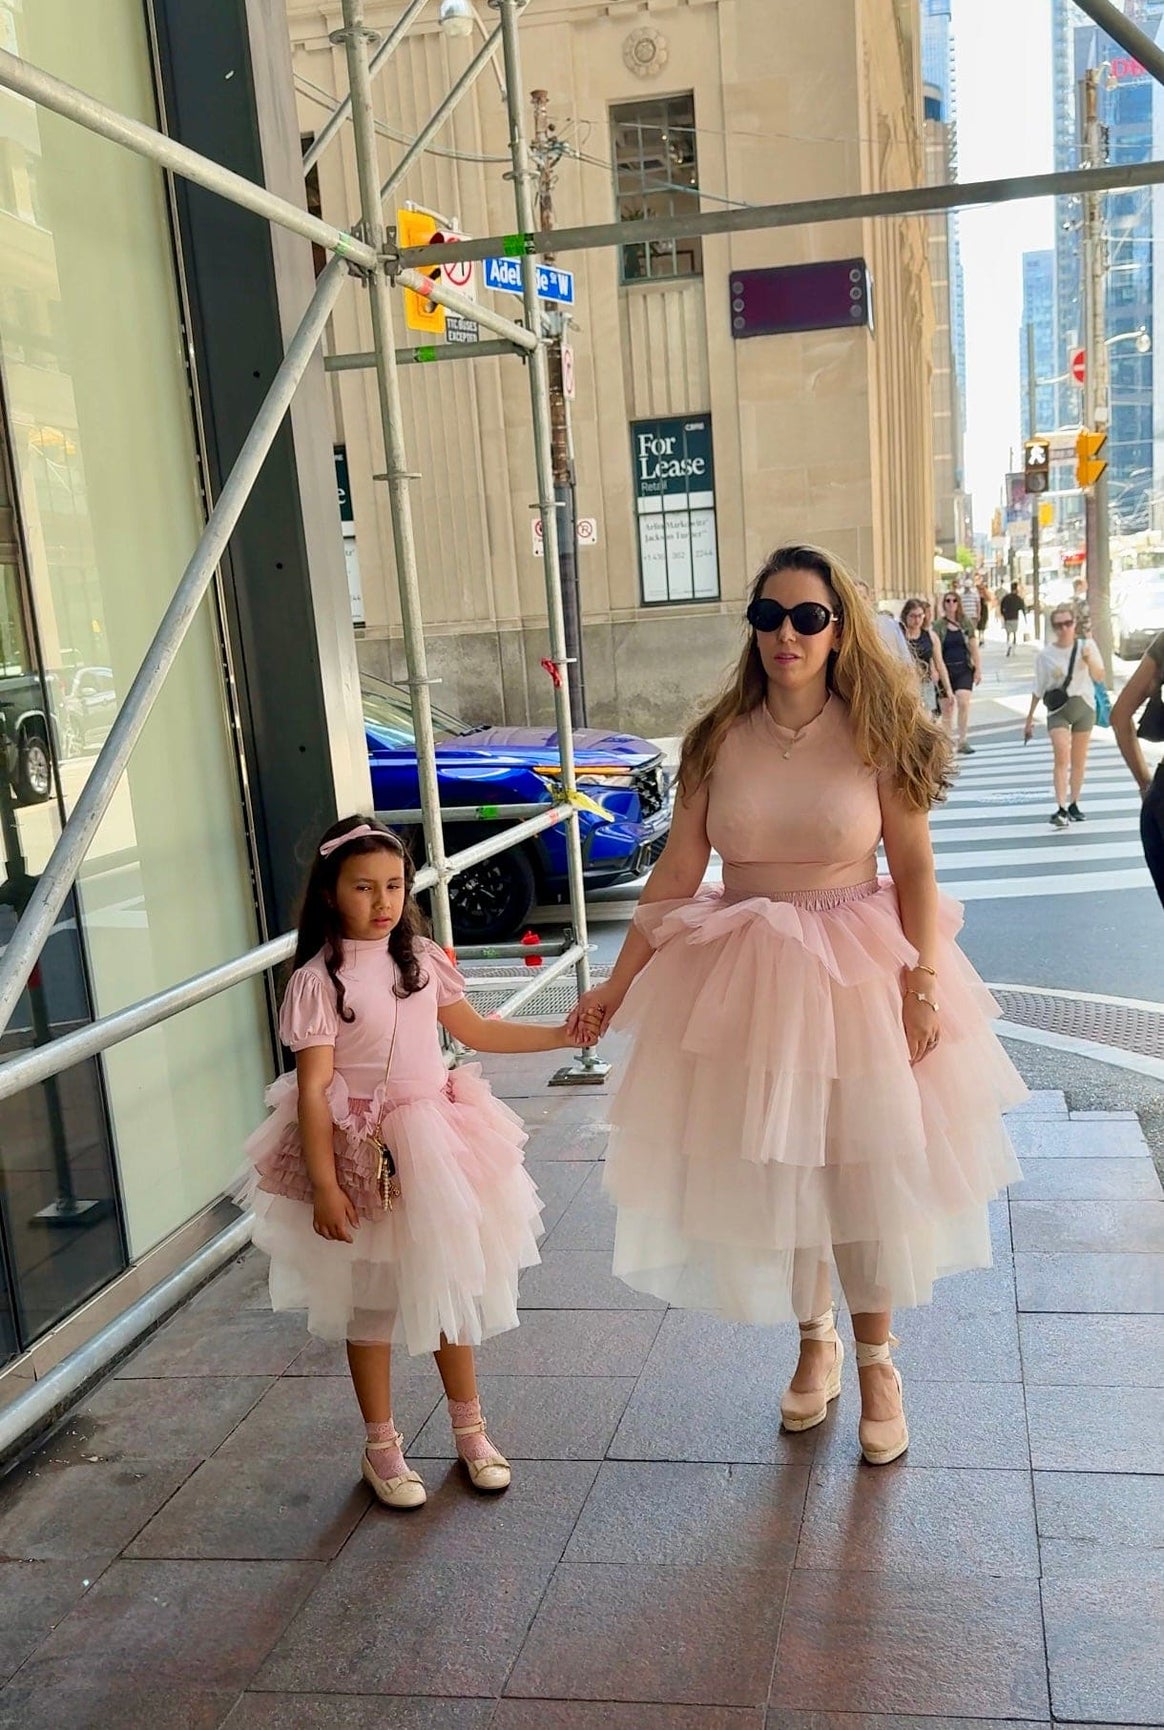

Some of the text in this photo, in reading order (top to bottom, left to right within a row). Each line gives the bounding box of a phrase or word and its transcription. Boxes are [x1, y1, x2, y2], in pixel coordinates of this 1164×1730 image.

[490, 259, 549, 291] Adelde
[558, 273, 569, 296] W
[637, 433, 676, 457] For
[639, 457, 706, 480] Lease
